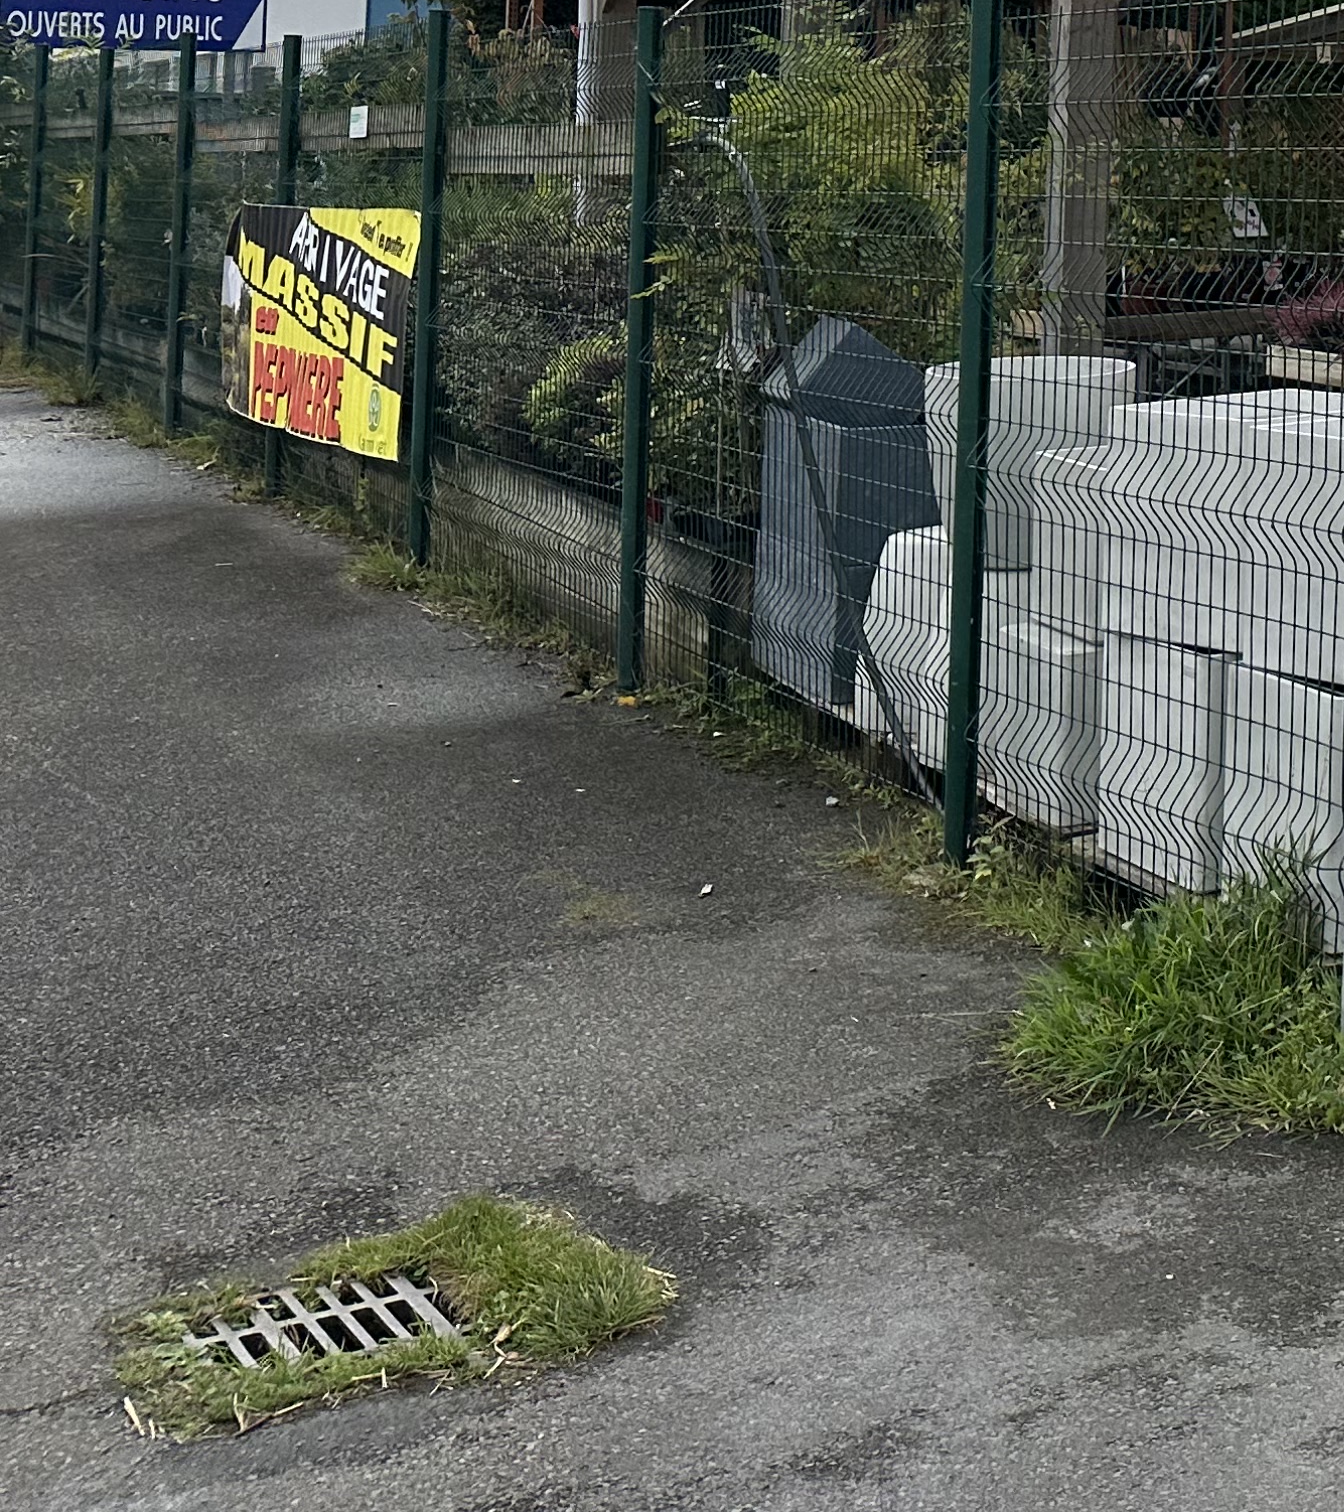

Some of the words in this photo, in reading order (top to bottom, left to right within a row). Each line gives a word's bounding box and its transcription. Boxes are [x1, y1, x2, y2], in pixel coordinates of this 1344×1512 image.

[7, 10, 104, 38] OUVERTS
[115, 13, 144, 39] AU
[155, 14, 223, 41] PUBLIC
[238, 226, 398, 378] MASSIF
[256, 306, 279, 335] en
